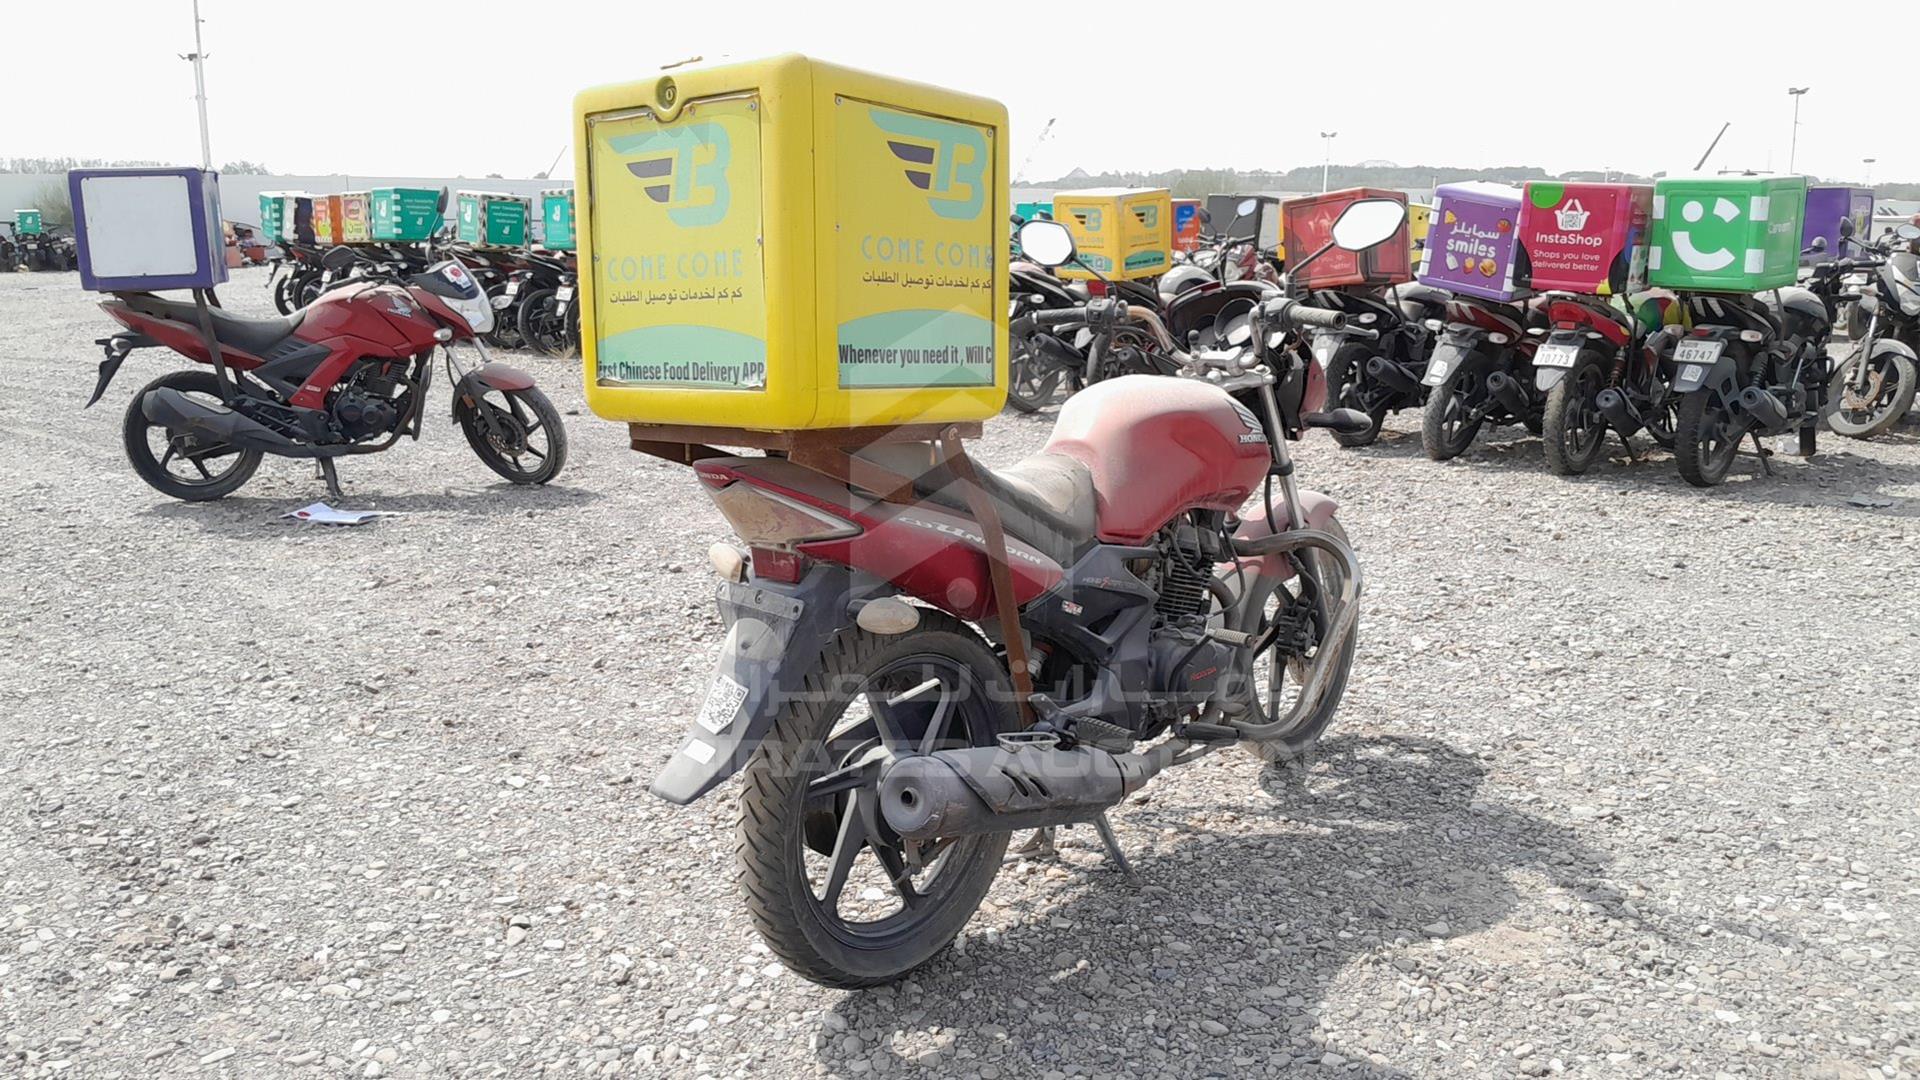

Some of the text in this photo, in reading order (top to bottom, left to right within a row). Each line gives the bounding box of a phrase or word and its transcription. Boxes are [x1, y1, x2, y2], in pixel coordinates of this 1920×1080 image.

[1450, 221, 1500, 240] سمايلز
[1535, 231, 1603, 247] InstaShop
[861, 234, 925, 265] COME
[1446, 238, 1496, 258] smiles
[1533, 249, 1600, 261] Shops you love
[607, 249, 743, 283] COME COME
[1531, 260, 1599, 271] delivered better
[862, 269, 992, 294] كم كم لخدمات توصيل الطلبات
[609, 287, 743, 306] كم كم لخدمات توصيل الطلبات
[838, 344, 898, 364] Whenever
[899, 349, 920, 368] you
[922, 346, 948, 364] need
[950, 346, 959, 364] it
[965, 346, 983, 364] Will
[598, 360, 617, 378] irst
[619, 361, 662, 380] Chinese
[663, 361, 690, 380] Food
[692, 362, 740, 386] Delivery
